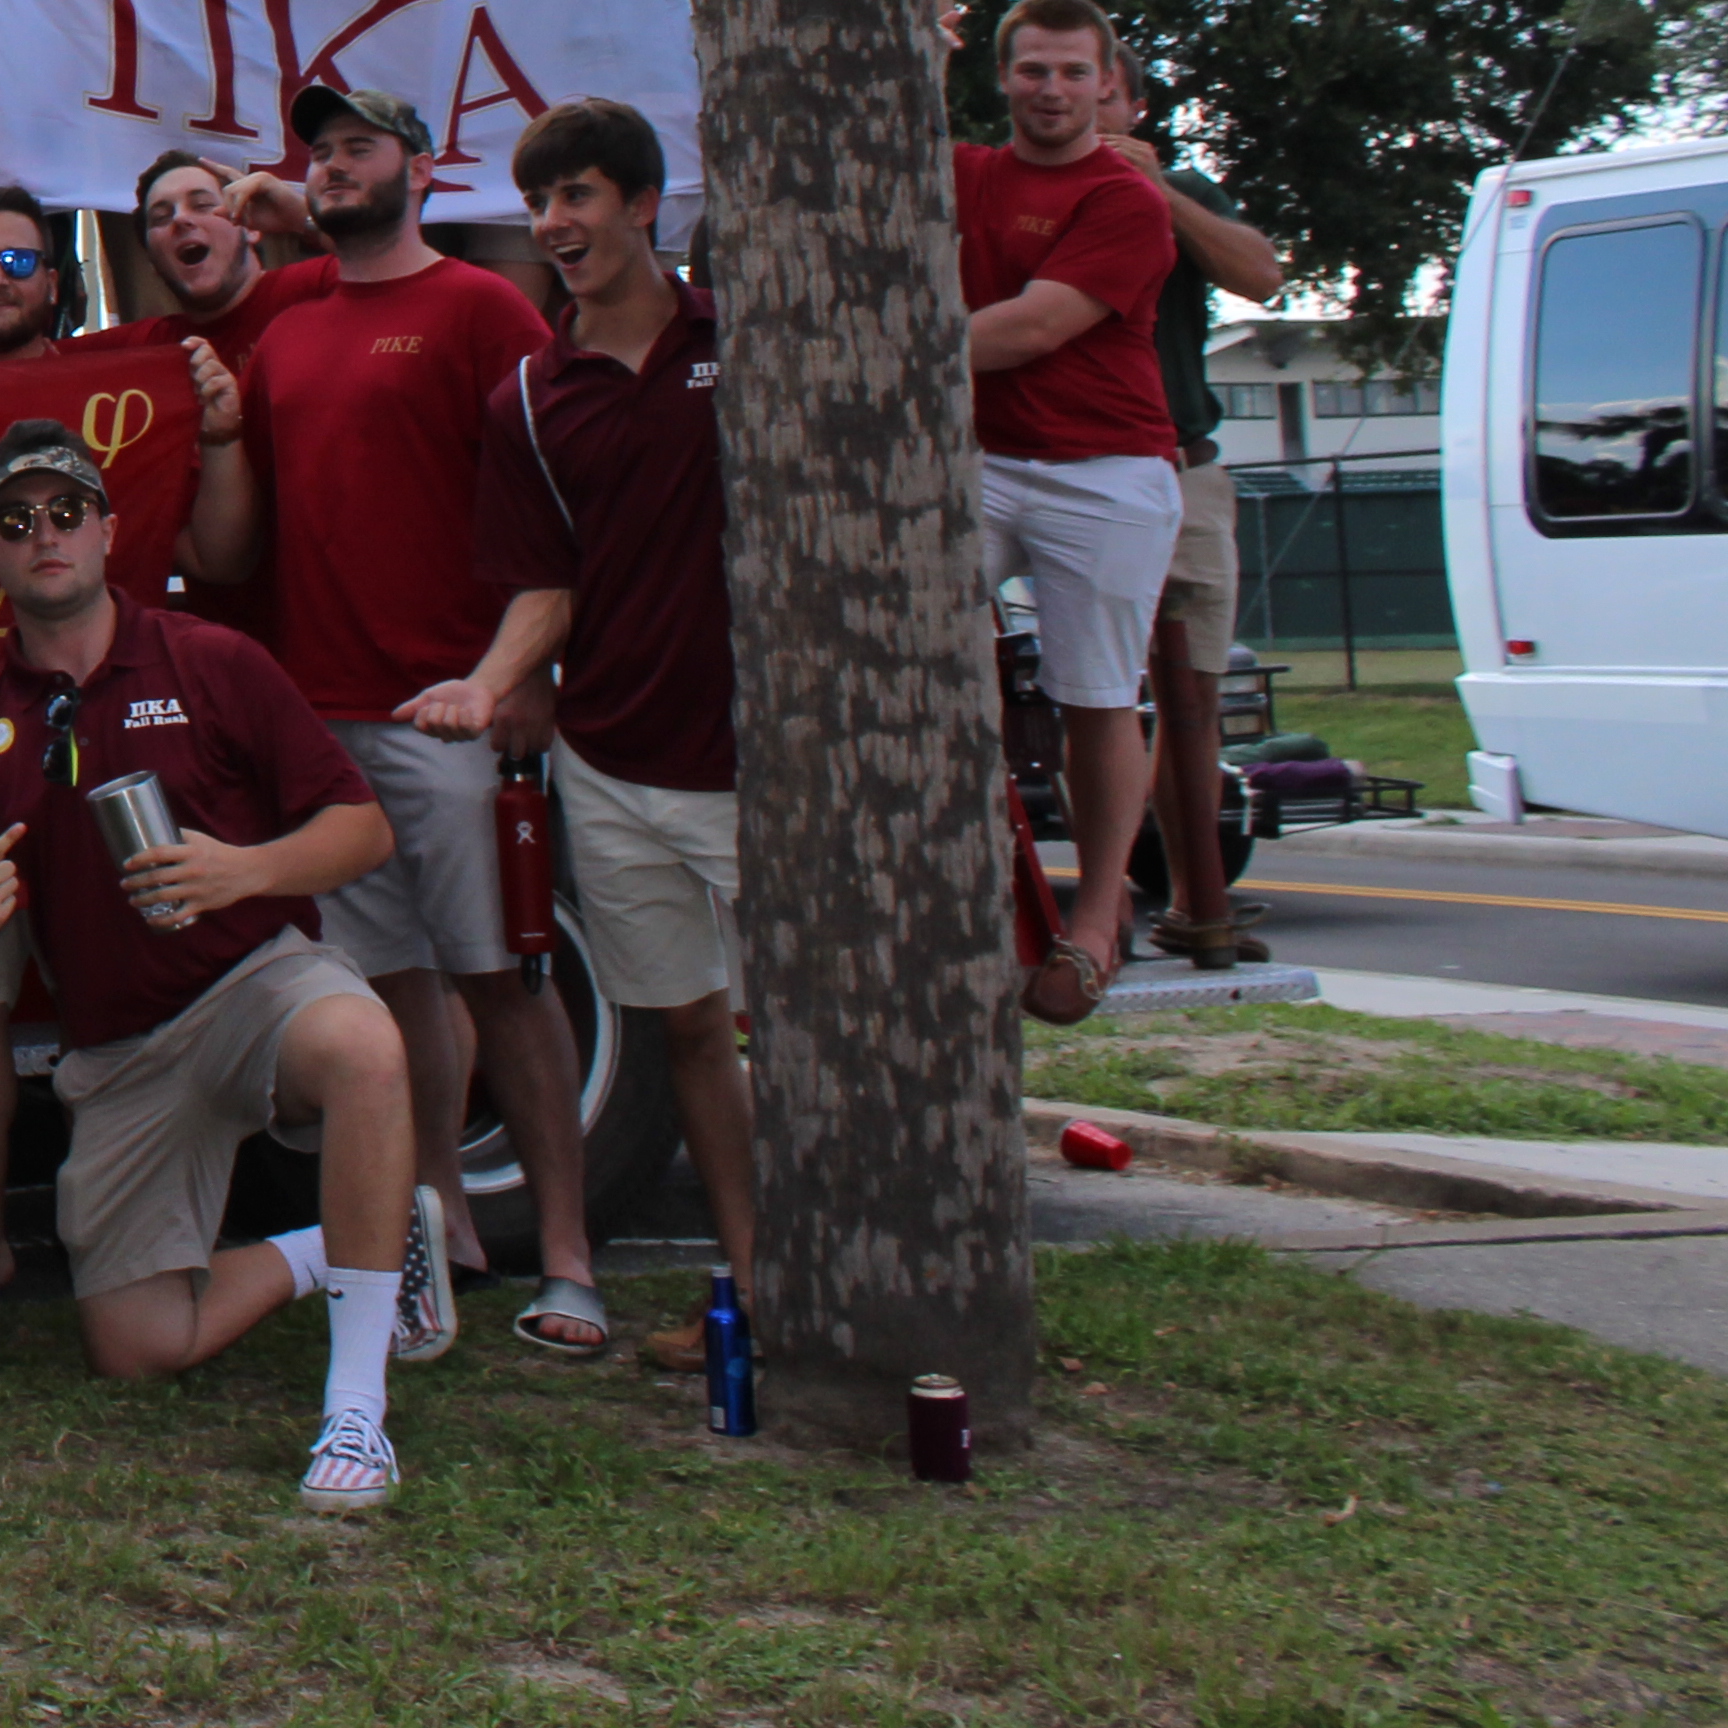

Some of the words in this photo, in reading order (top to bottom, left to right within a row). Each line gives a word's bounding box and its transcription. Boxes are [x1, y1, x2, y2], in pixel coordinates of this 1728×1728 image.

[370, 335, 423, 355] PIKE
[124, 716, 151, 729] Fall
[153, 713, 189, 725] Rush
